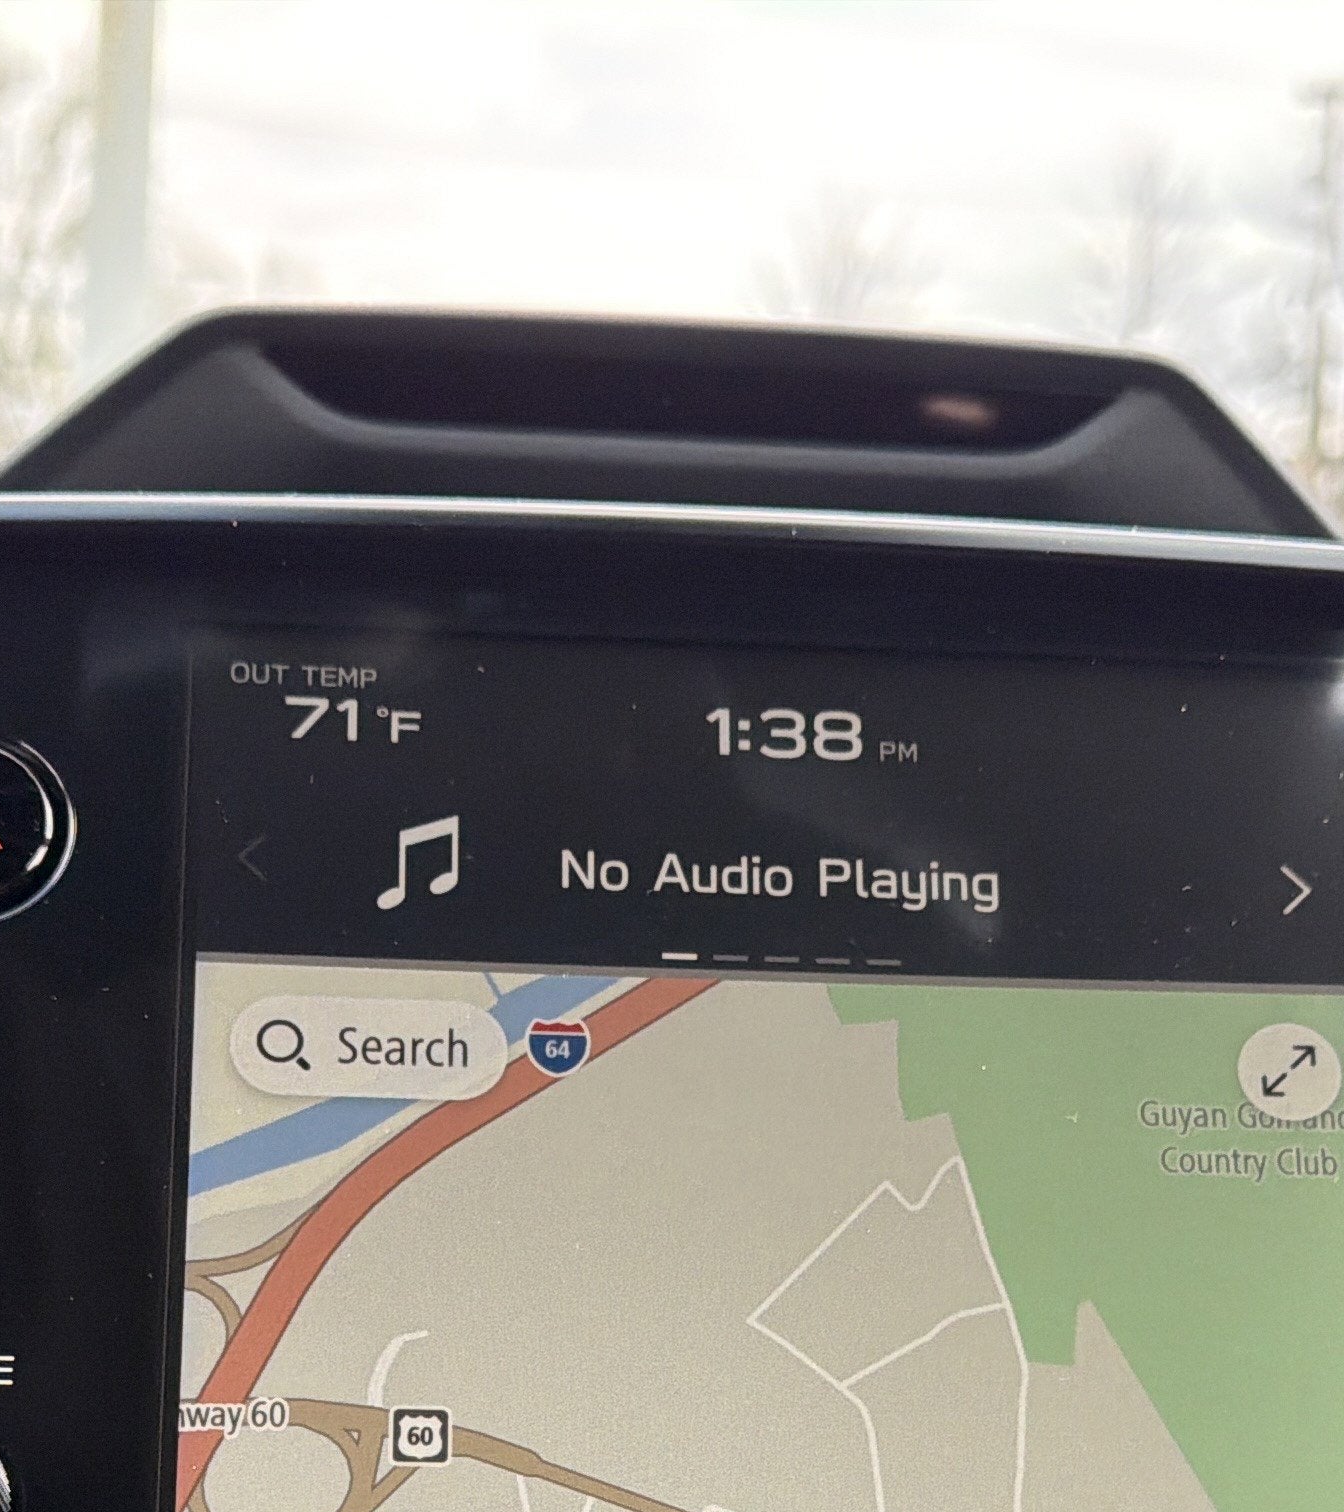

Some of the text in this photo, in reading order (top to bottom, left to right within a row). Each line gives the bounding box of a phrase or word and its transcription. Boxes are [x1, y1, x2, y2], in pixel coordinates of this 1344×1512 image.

[230, 662, 377, 689] OUT TEMP
[706, 708, 918, 762] 1:38 PM
[561, 849, 999, 913] No Audio Playing
[338, 1027, 468, 1067] Search
[545, 1040, 570, 1059] 64
[1140, 1100, 1227, 1135] Guyan
[1160, 1147, 1338, 1182] Country Club
[251, 1400, 286, 1428] 60
[407, 1426, 434, 1447] 60
